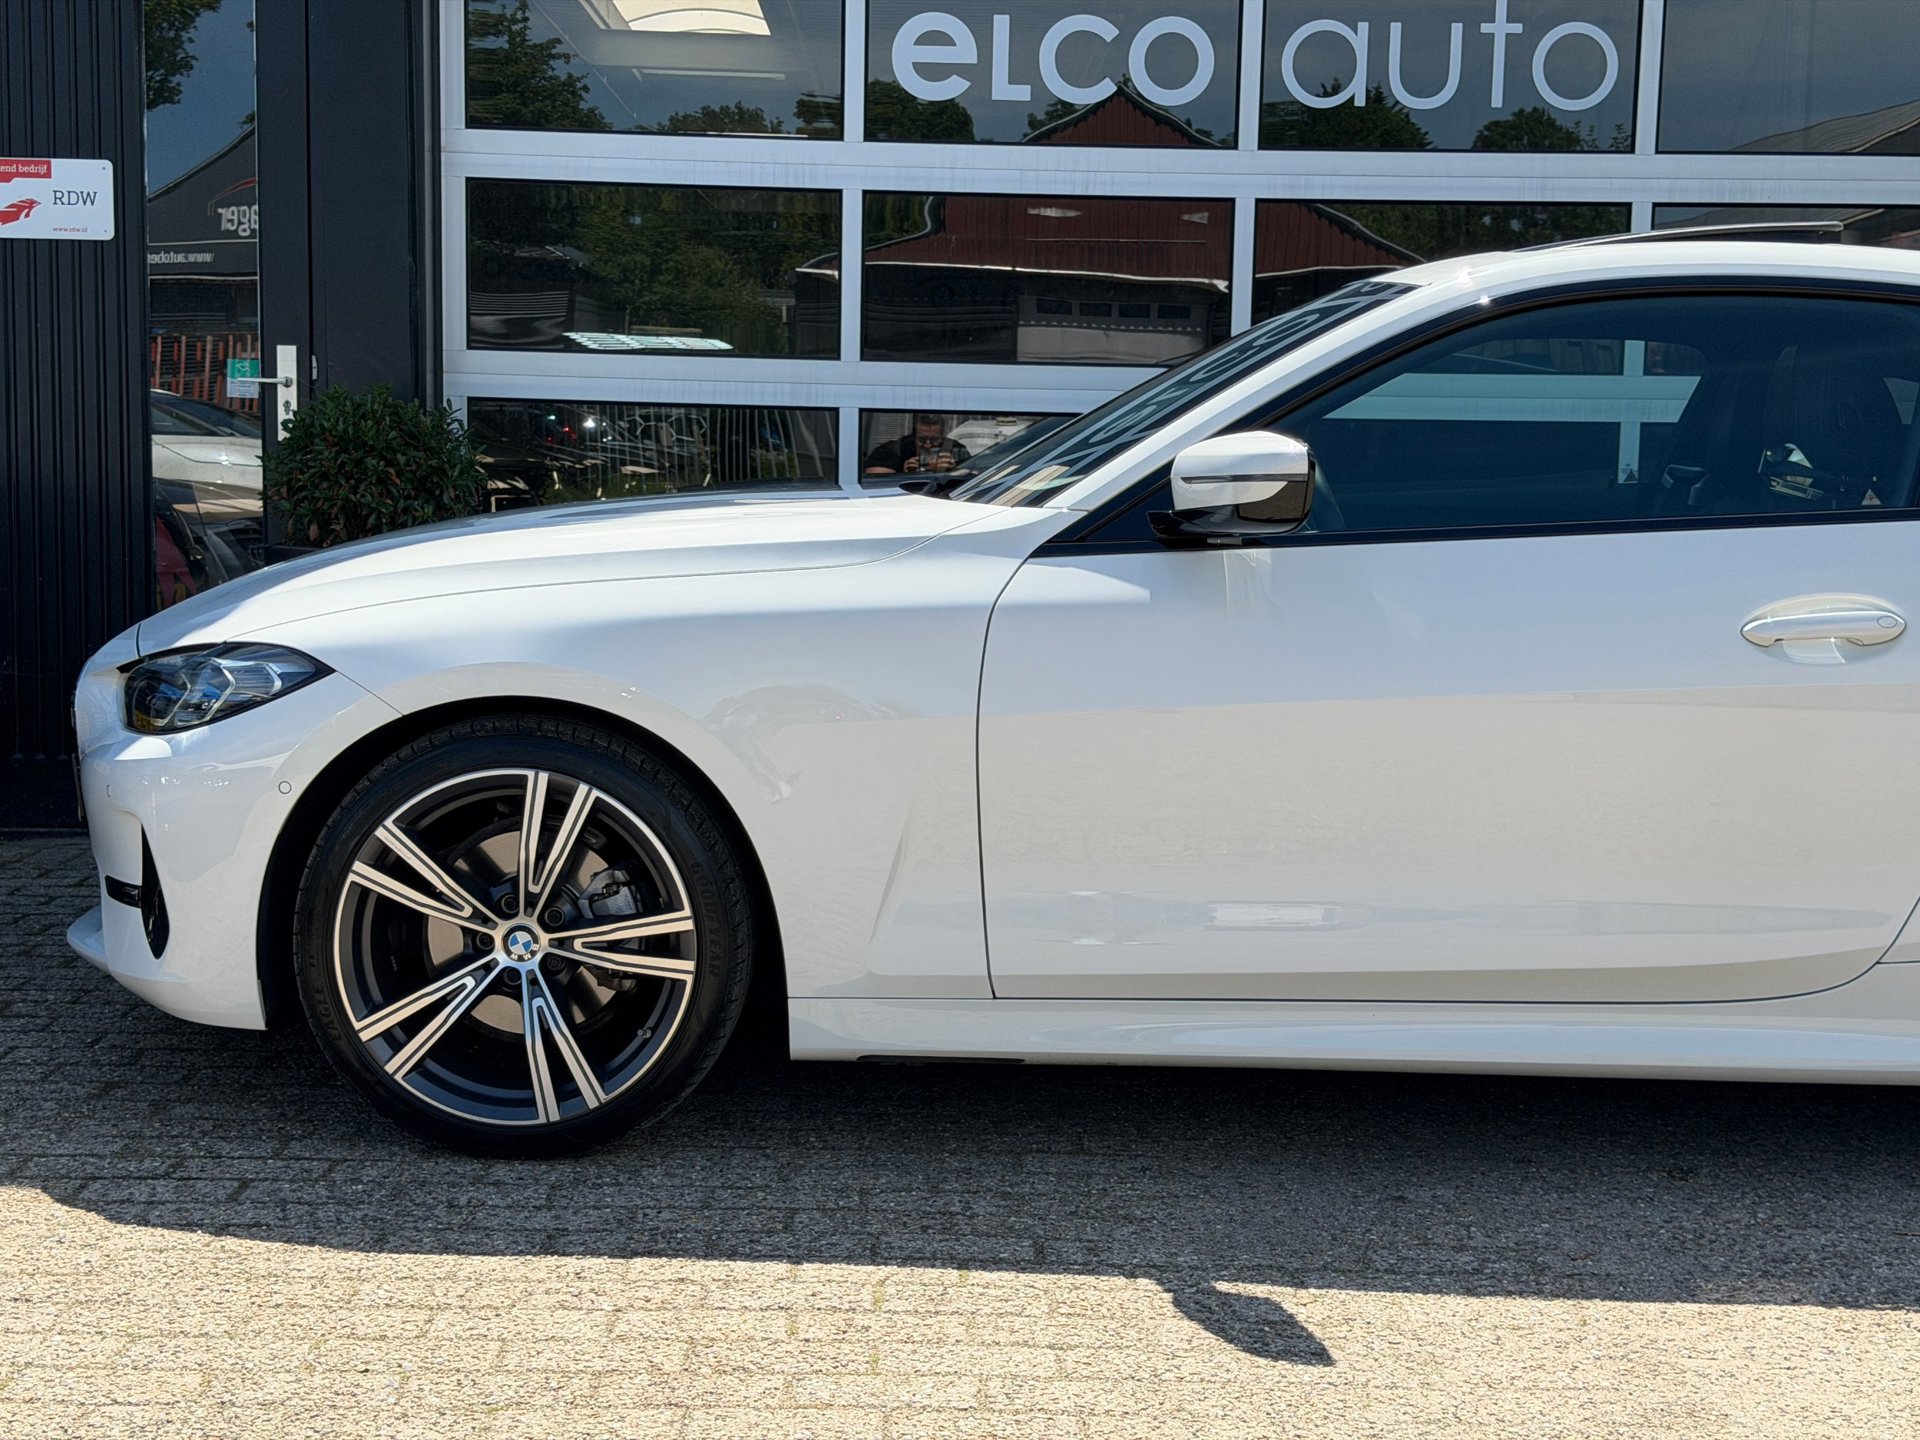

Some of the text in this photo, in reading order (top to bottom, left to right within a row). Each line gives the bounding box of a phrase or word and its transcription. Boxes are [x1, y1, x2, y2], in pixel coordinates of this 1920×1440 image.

[1280, 0, 1620, 112] auto
[18, 163, 48, 175] bedrijf
[52, 189, 98, 207] RDW
